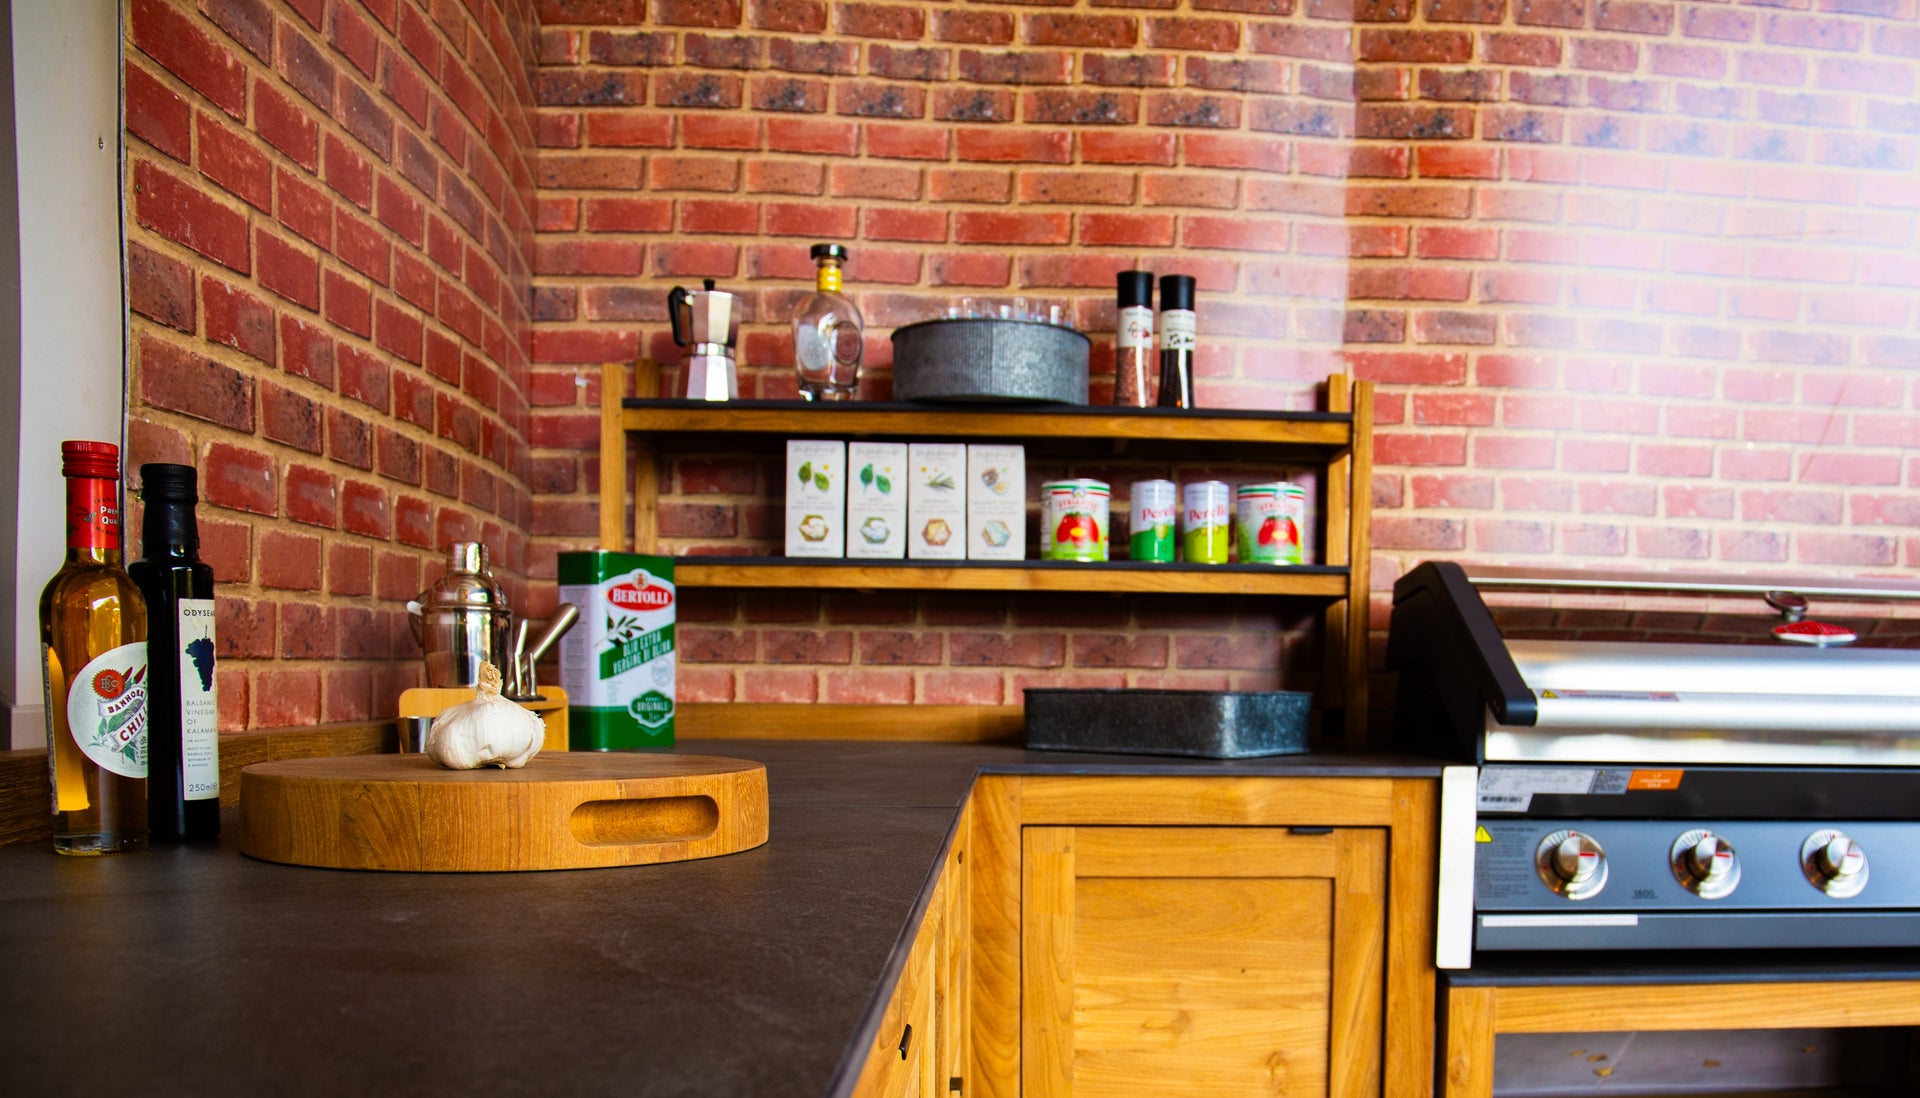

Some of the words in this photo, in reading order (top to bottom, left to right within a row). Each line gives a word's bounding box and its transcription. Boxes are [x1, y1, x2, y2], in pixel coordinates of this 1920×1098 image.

[612, 588, 669, 605] BERTOLLI
[623, 639, 639, 657] OLIO
[640, 630, 662, 651] EXTRA
[613, 650, 643, 675] VERGINE
[643, 647, 651, 663] DI
[652, 639, 671, 659] OLIVA
[637, 702, 668, 712] ORIGINALE
